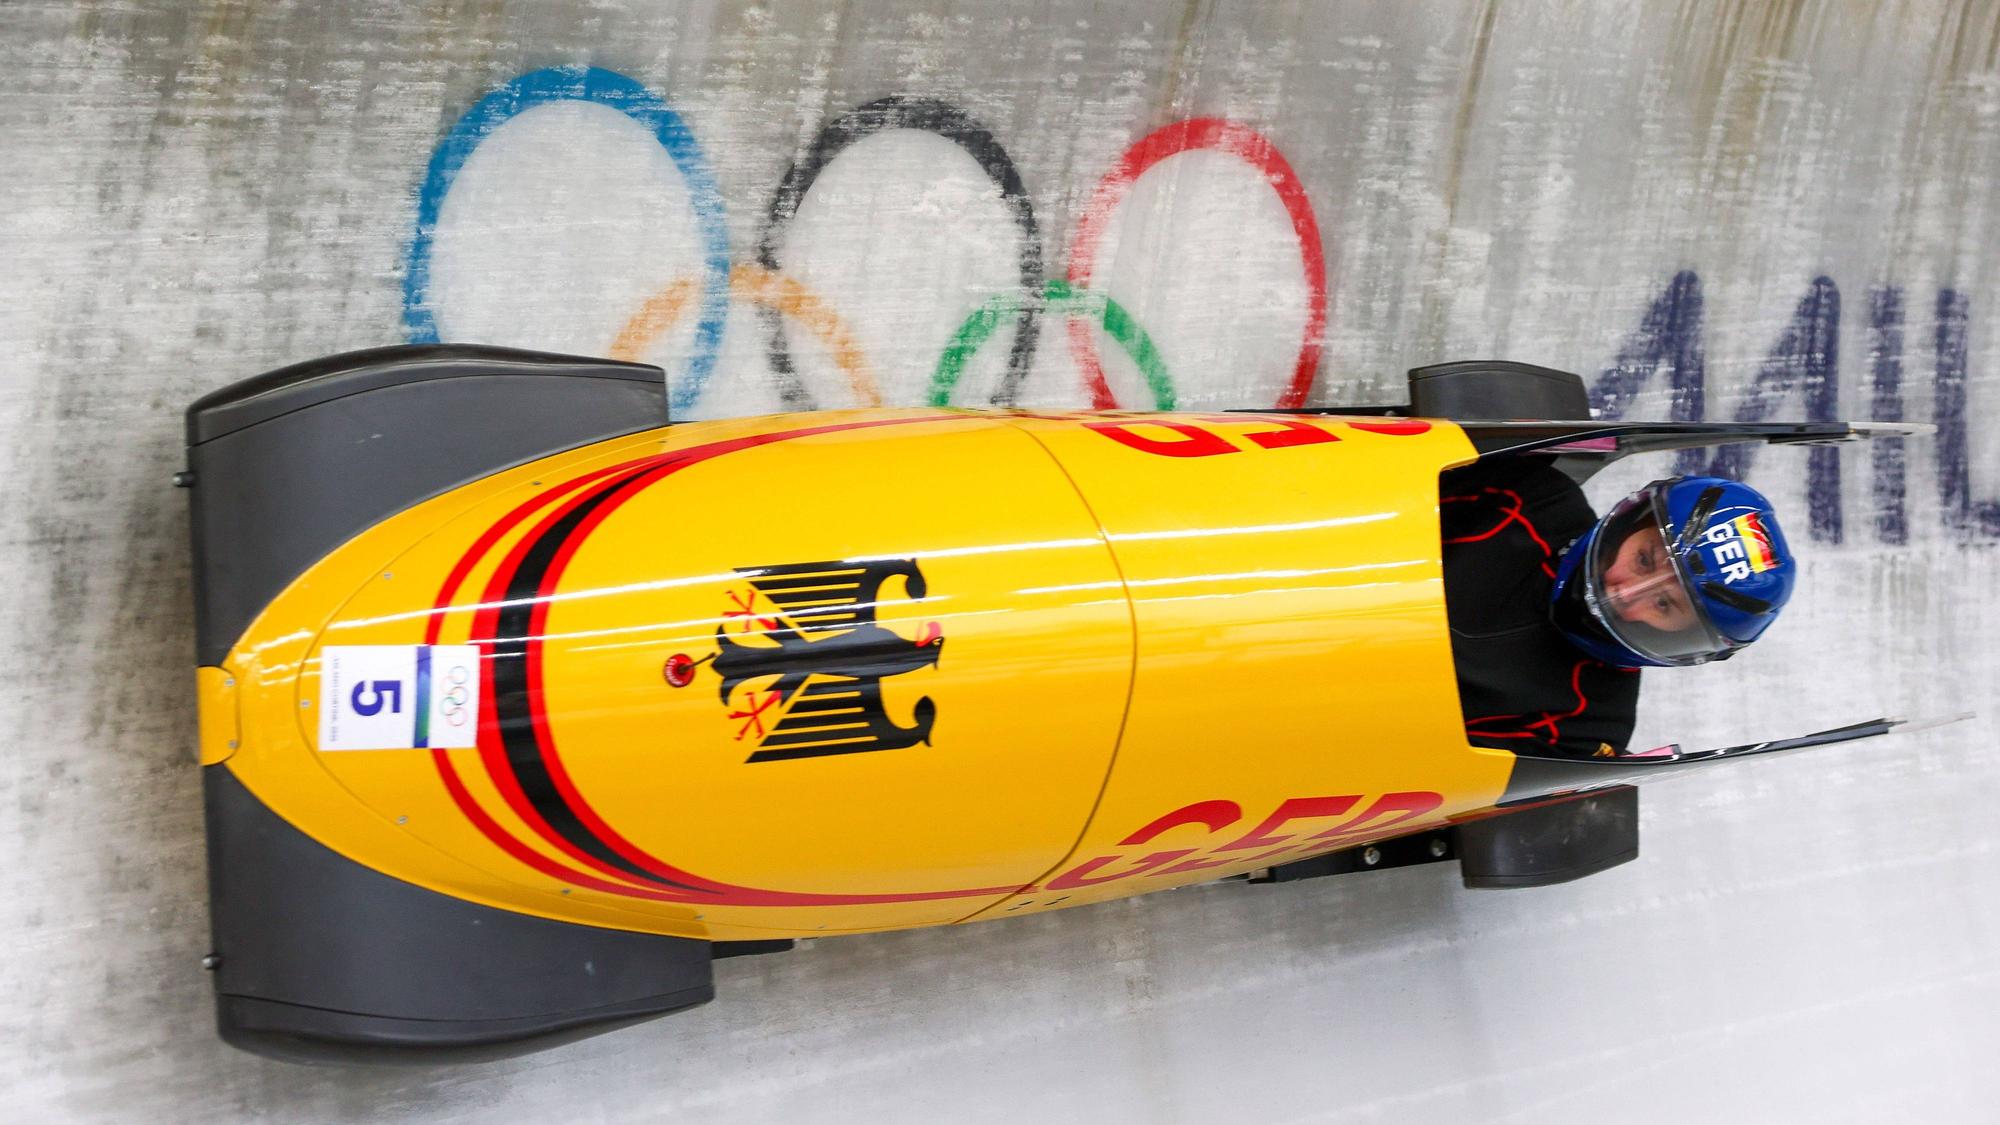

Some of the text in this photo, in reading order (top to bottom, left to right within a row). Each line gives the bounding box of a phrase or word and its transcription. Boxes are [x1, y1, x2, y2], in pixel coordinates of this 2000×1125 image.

[1707, 523, 1750, 585] GER
[351, 680, 402, 717] 5
[1046, 791, 1448, 891] GER
